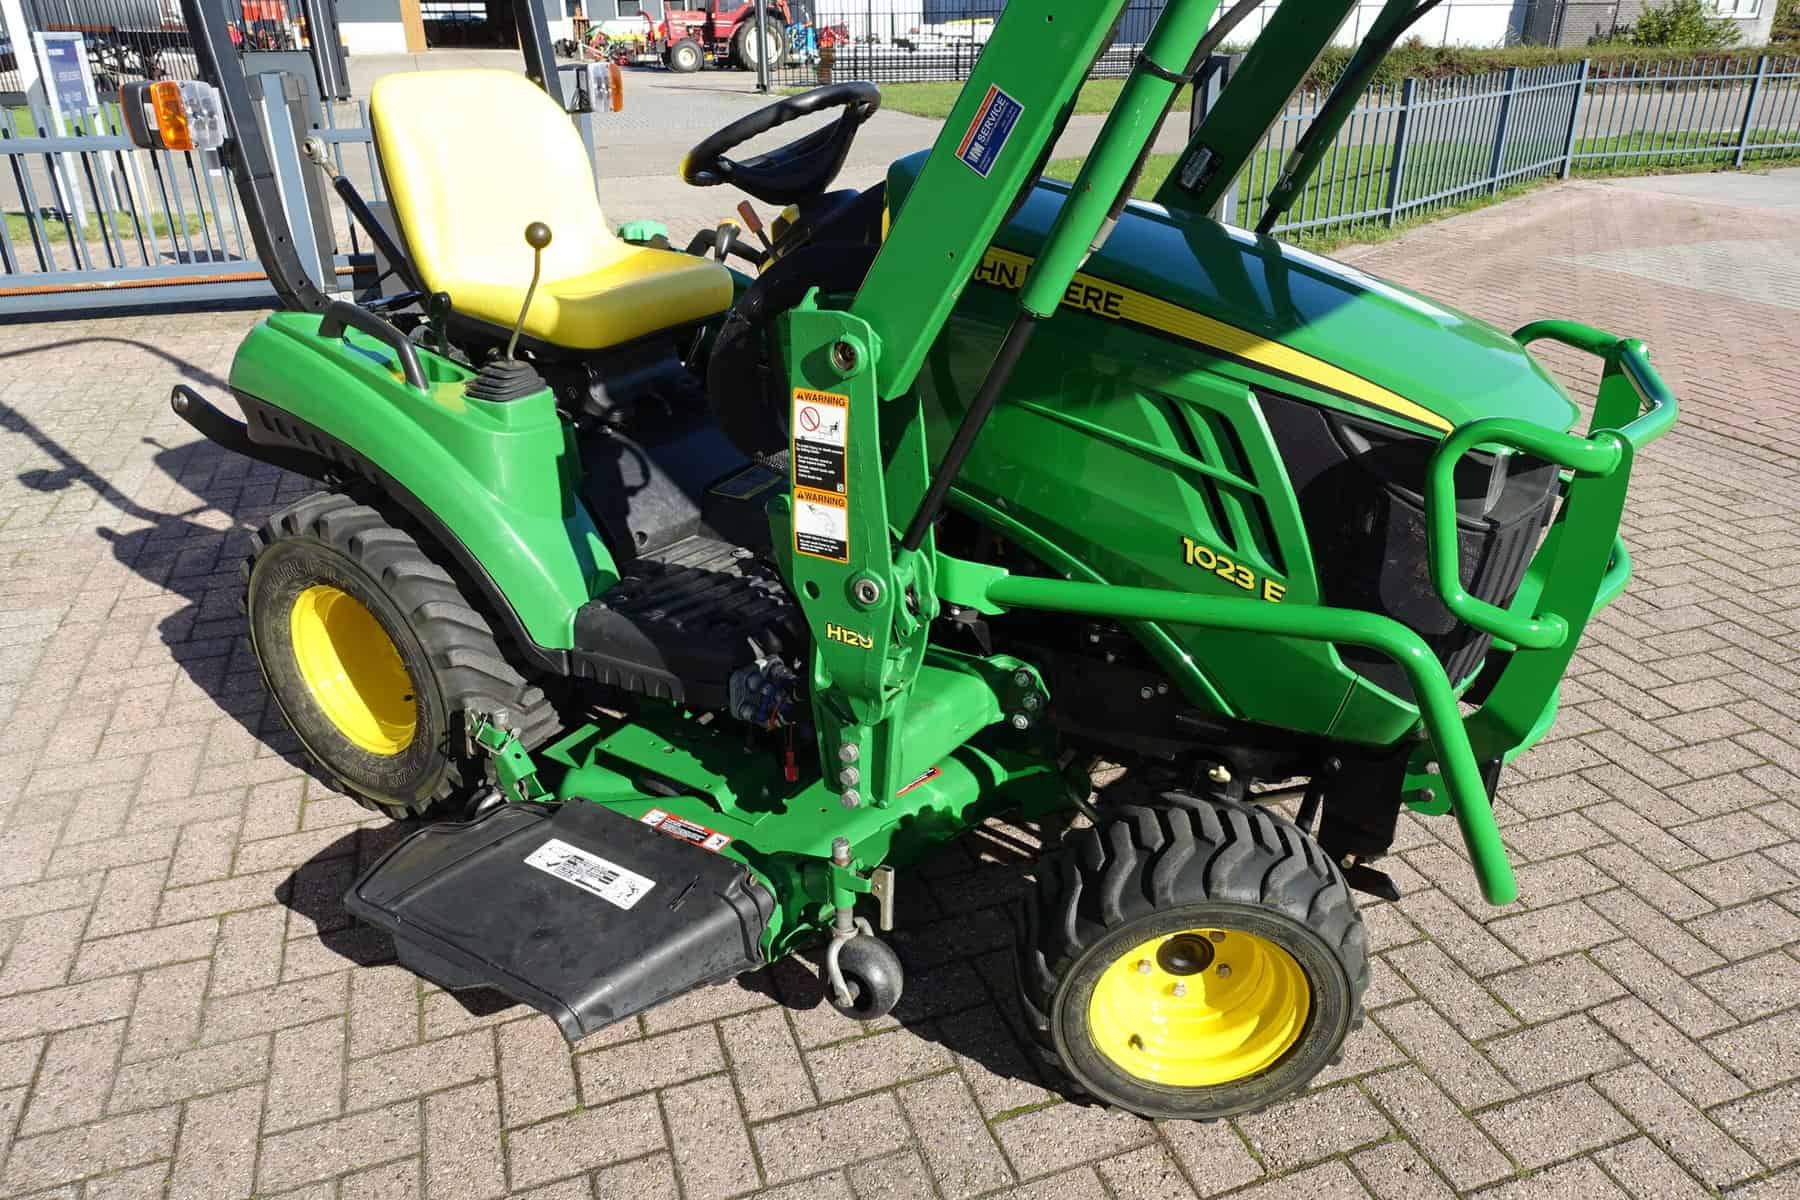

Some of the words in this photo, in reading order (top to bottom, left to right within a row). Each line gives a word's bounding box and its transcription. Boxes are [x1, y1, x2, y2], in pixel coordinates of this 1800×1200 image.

[977, 95, 1007, 143] SERVICE
[977, 260, 1019, 287] HN
[1063, 282, 1124, 313] ERE
[803, 392, 845, 408] WARNING
[803, 493, 845, 508] WARNING
[1183, 536, 1255, 590] 1023
[1264, 577, 1286, 603] E
